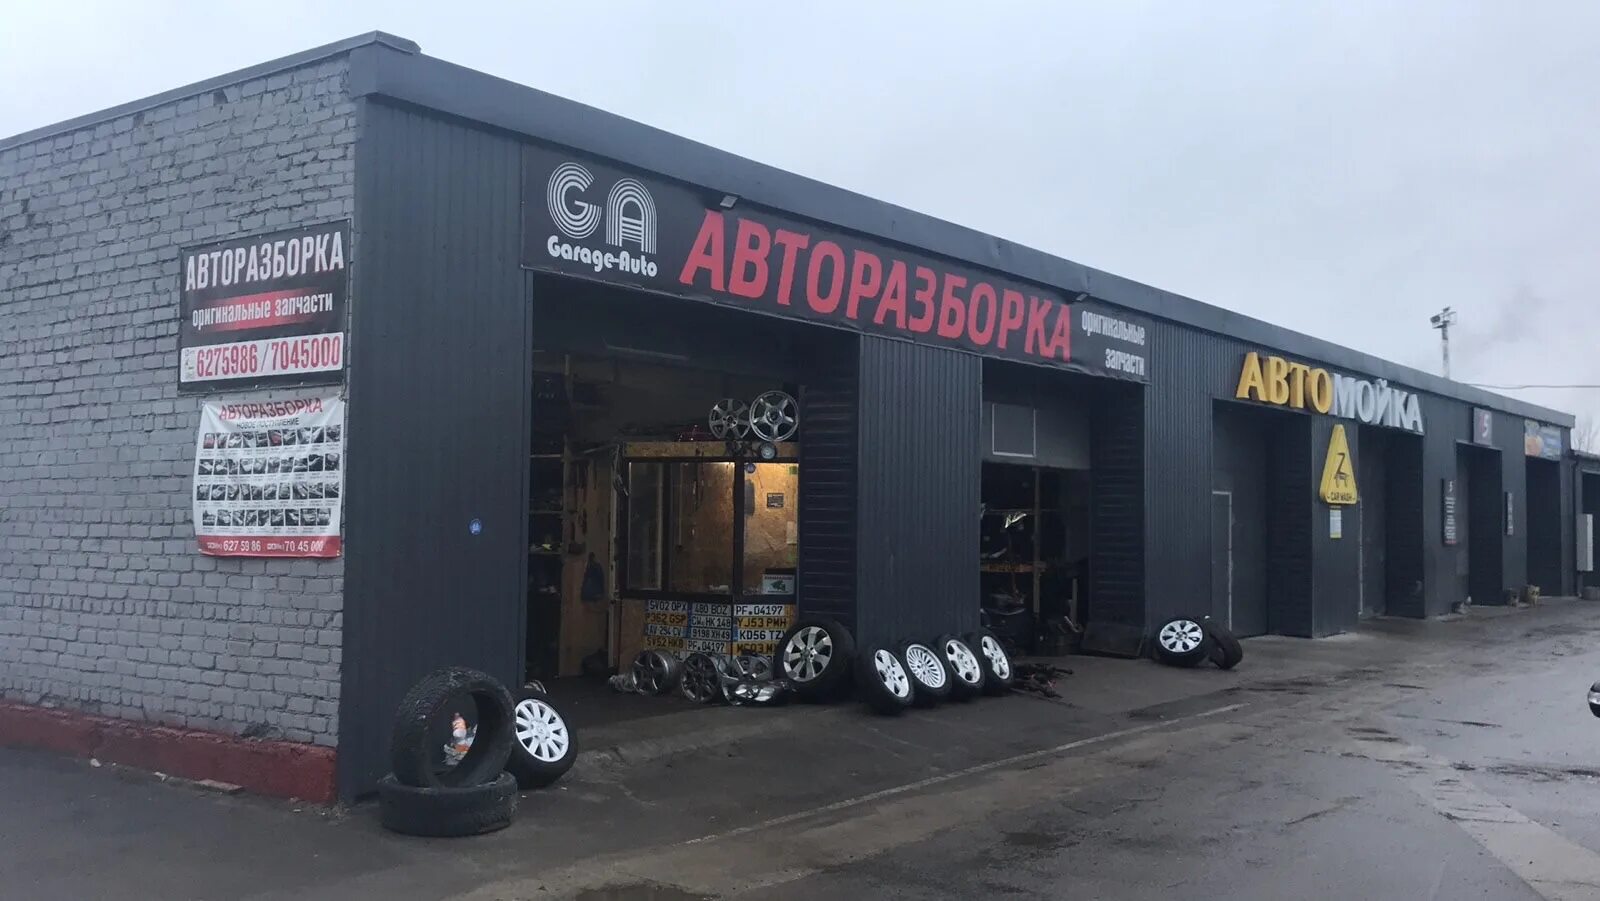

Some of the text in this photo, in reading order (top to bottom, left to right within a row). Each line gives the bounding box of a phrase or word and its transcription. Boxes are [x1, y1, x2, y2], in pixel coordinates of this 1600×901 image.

[547, 162, 657, 255] GA
[185, 231, 344, 291] АВТОРАЗБОРКА
[547, 235, 658, 277] Garage-Auto
[679, 208, 1071, 362] АВТОРАЗБОРКА
[192, 293, 333, 330] оригинальные запчасти
[1081, 310, 1145, 345] оригинальные
[196, 344, 258, 377] 6275986
[271, 336, 340, 370] 7045000
[1105, 348, 1145, 376] запчасти
[219, 397, 323, 420] АВТОРАЗБОРКА
[1236, 351, 1424, 433] АВТОМОЙКА
[223, 541, 239, 552] 627
[240, 541, 249, 551] 59
[251, 541, 261, 551] 86
[285, 541, 295, 552] 70
[297, 541, 308, 552] 45
[736, 605, 783, 615] PF.04197
[737, 617, 787, 627] YJ53 PMH
[739, 630, 766, 640] KD56
